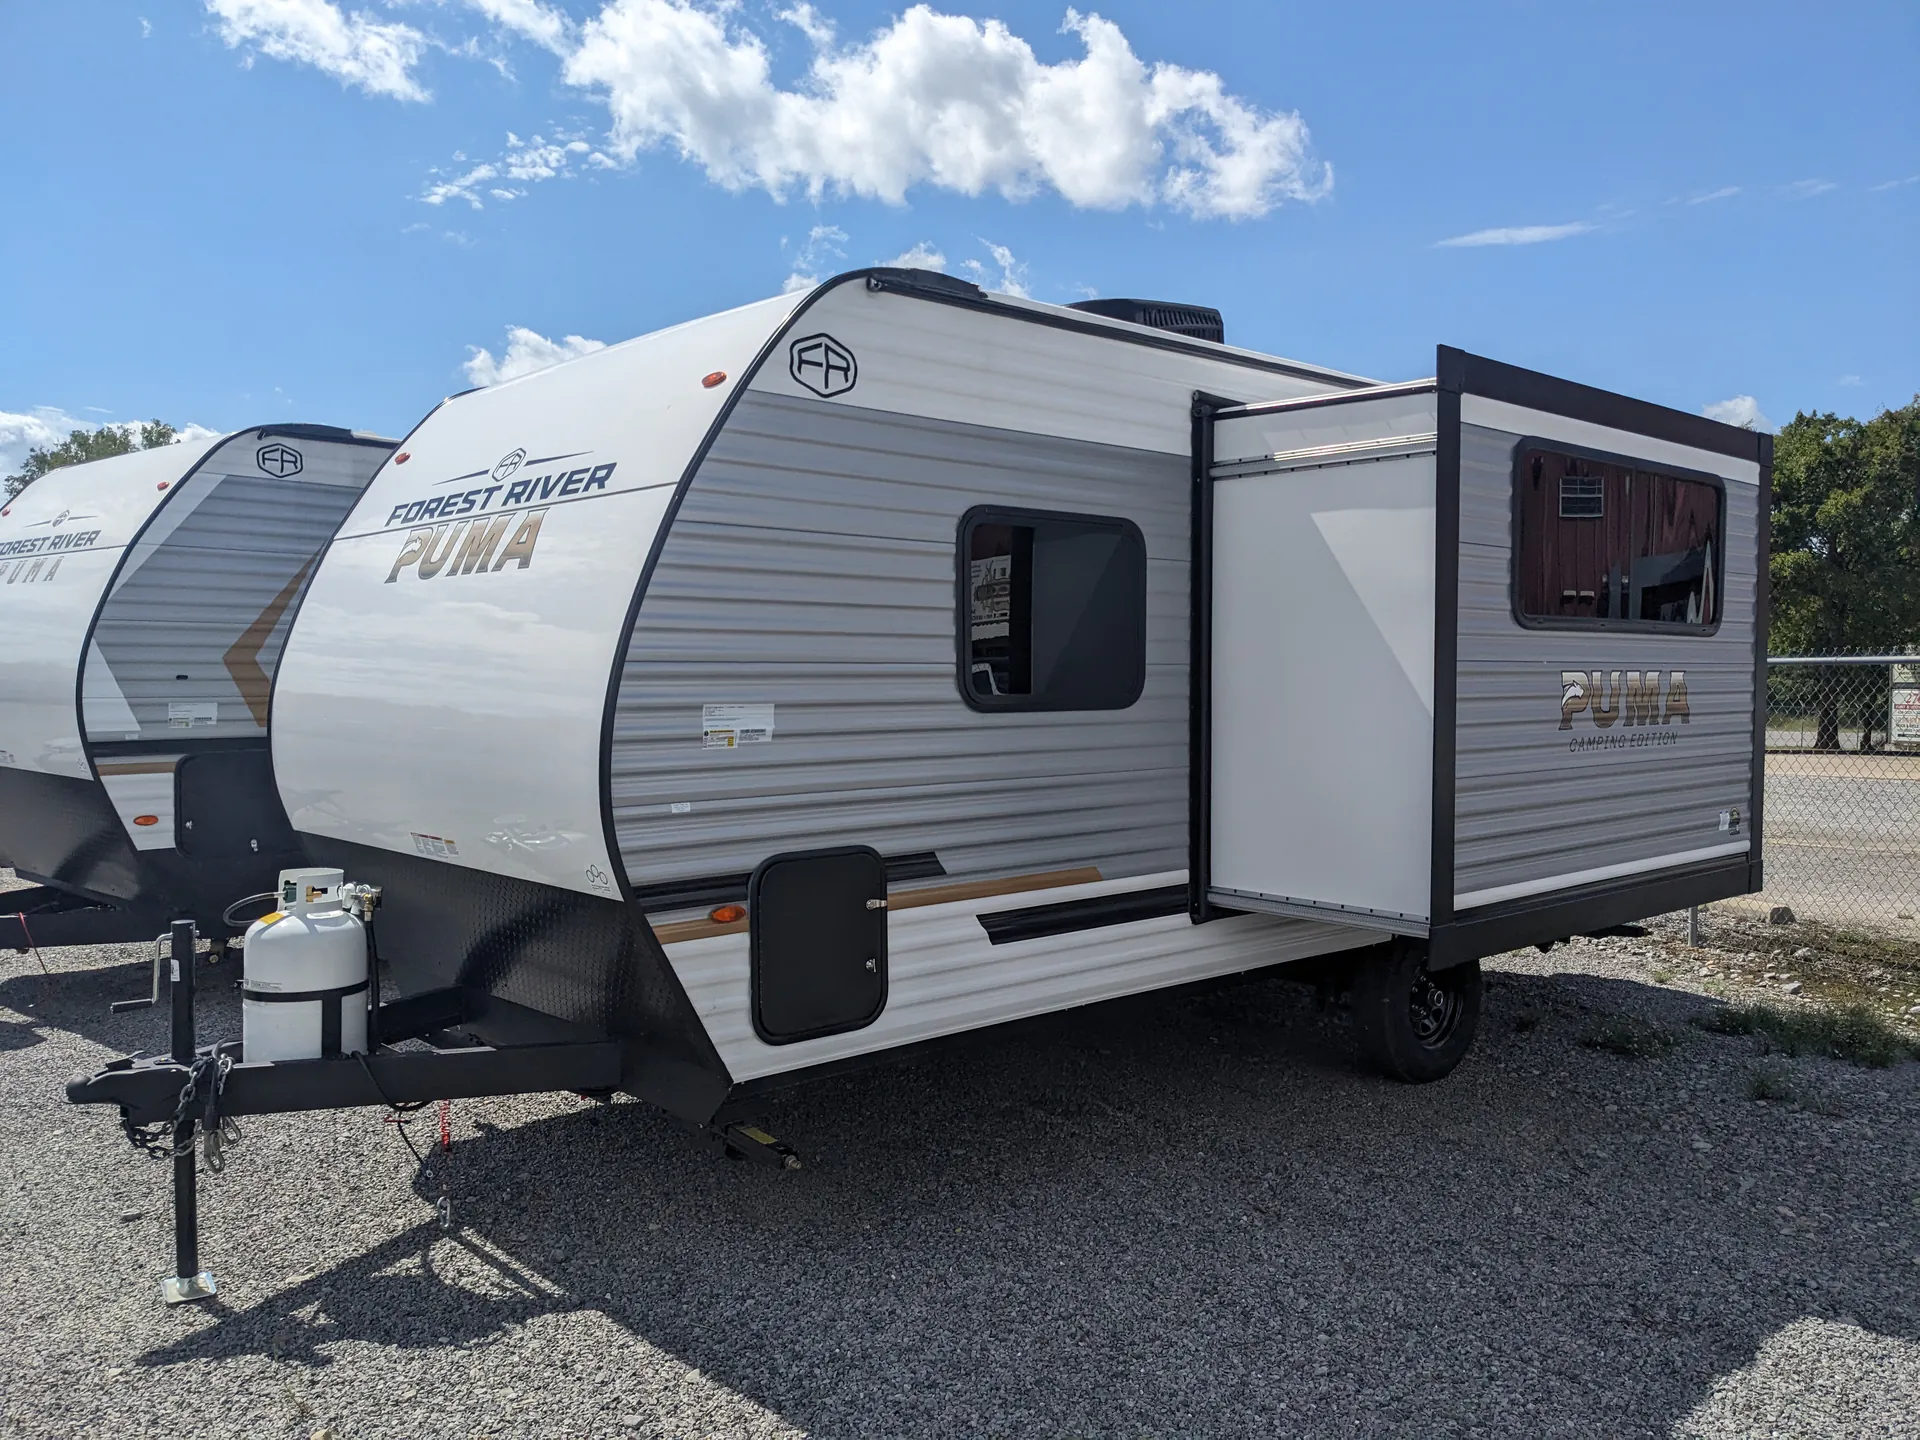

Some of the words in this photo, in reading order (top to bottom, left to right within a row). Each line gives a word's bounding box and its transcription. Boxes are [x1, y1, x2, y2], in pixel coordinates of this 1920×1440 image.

[384, 485, 504, 528] FOREST
[501, 462, 618, 507] RIVER
[46, 529, 102, 551] RIVER
[384, 507, 551, 584] PUMA
[1558, 670, 1691, 731] PUMA
[1568, 734, 1626, 753] CAMPING
[1629, 731, 1678, 748] EDITION
